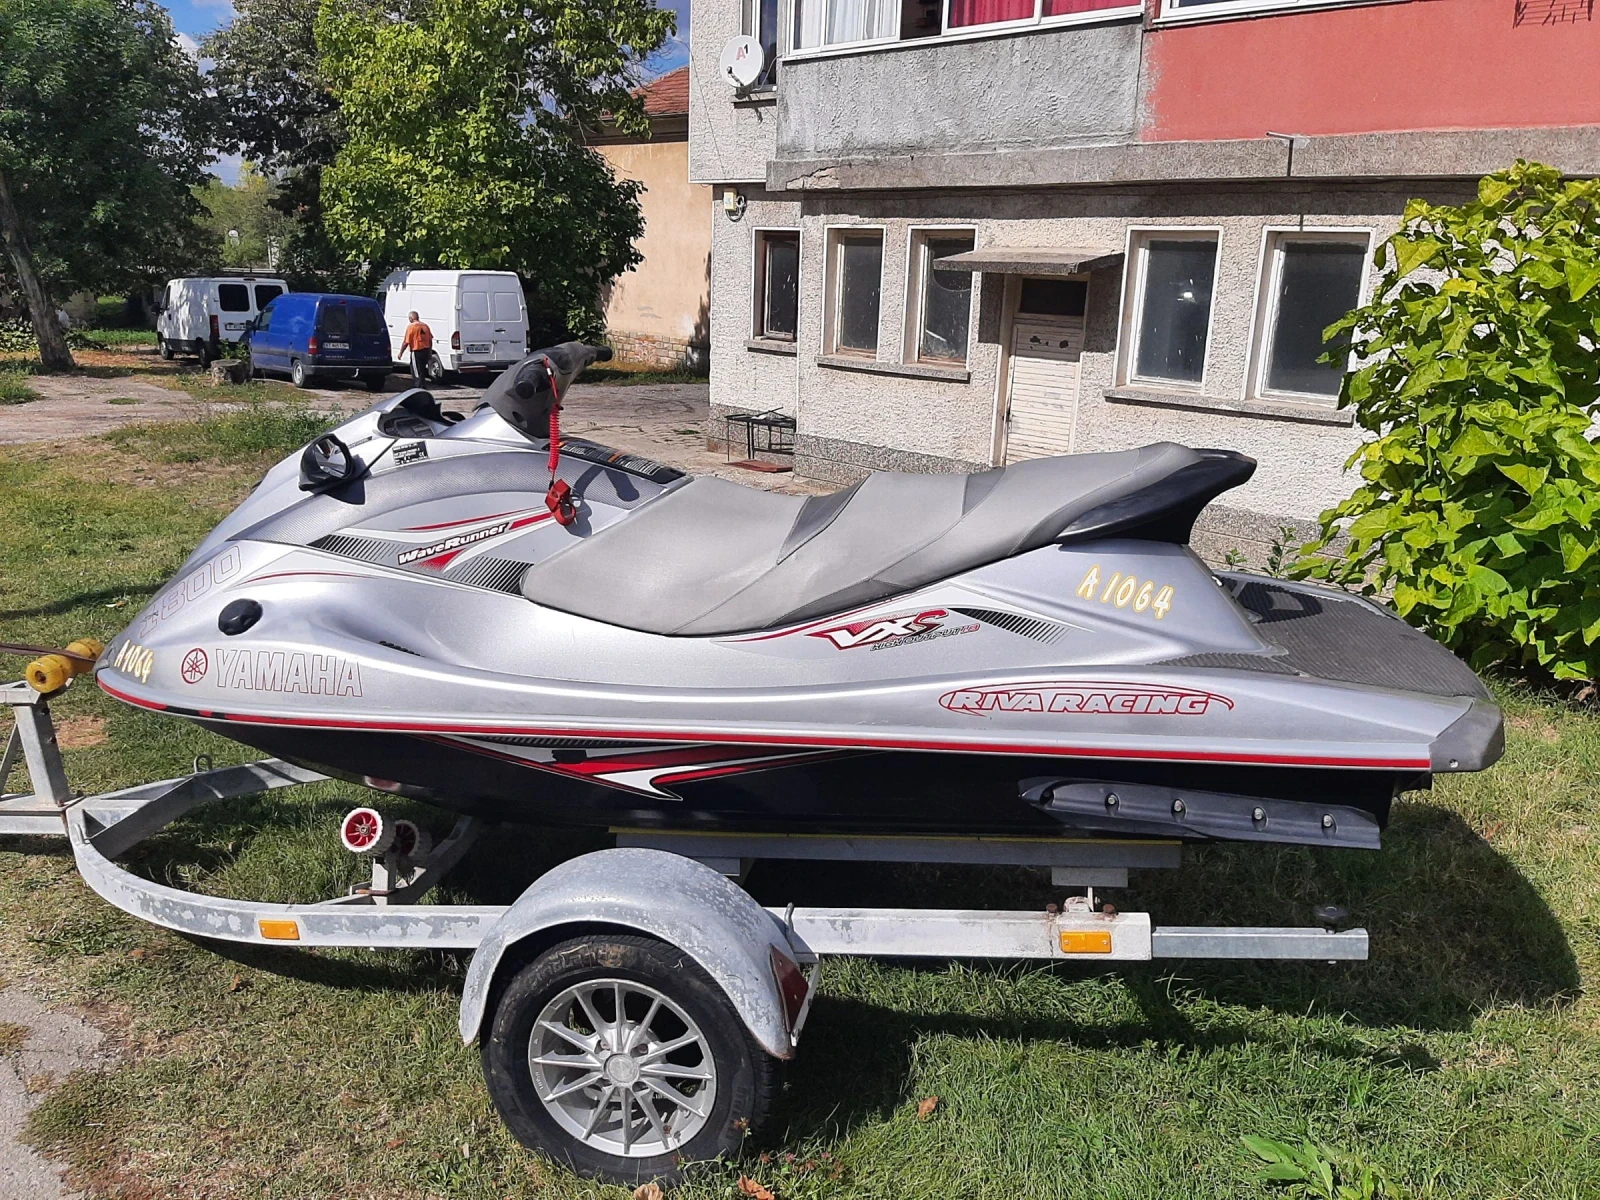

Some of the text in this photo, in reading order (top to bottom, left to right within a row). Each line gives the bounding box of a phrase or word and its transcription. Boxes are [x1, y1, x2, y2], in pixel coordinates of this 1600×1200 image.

[735, 43, 749, 61] A1
[398, 522, 509, 565] WaveRunner
[215, 648, 363, 698] YAMAHA
[949, 690, 1210, 715] RIVA RACING
